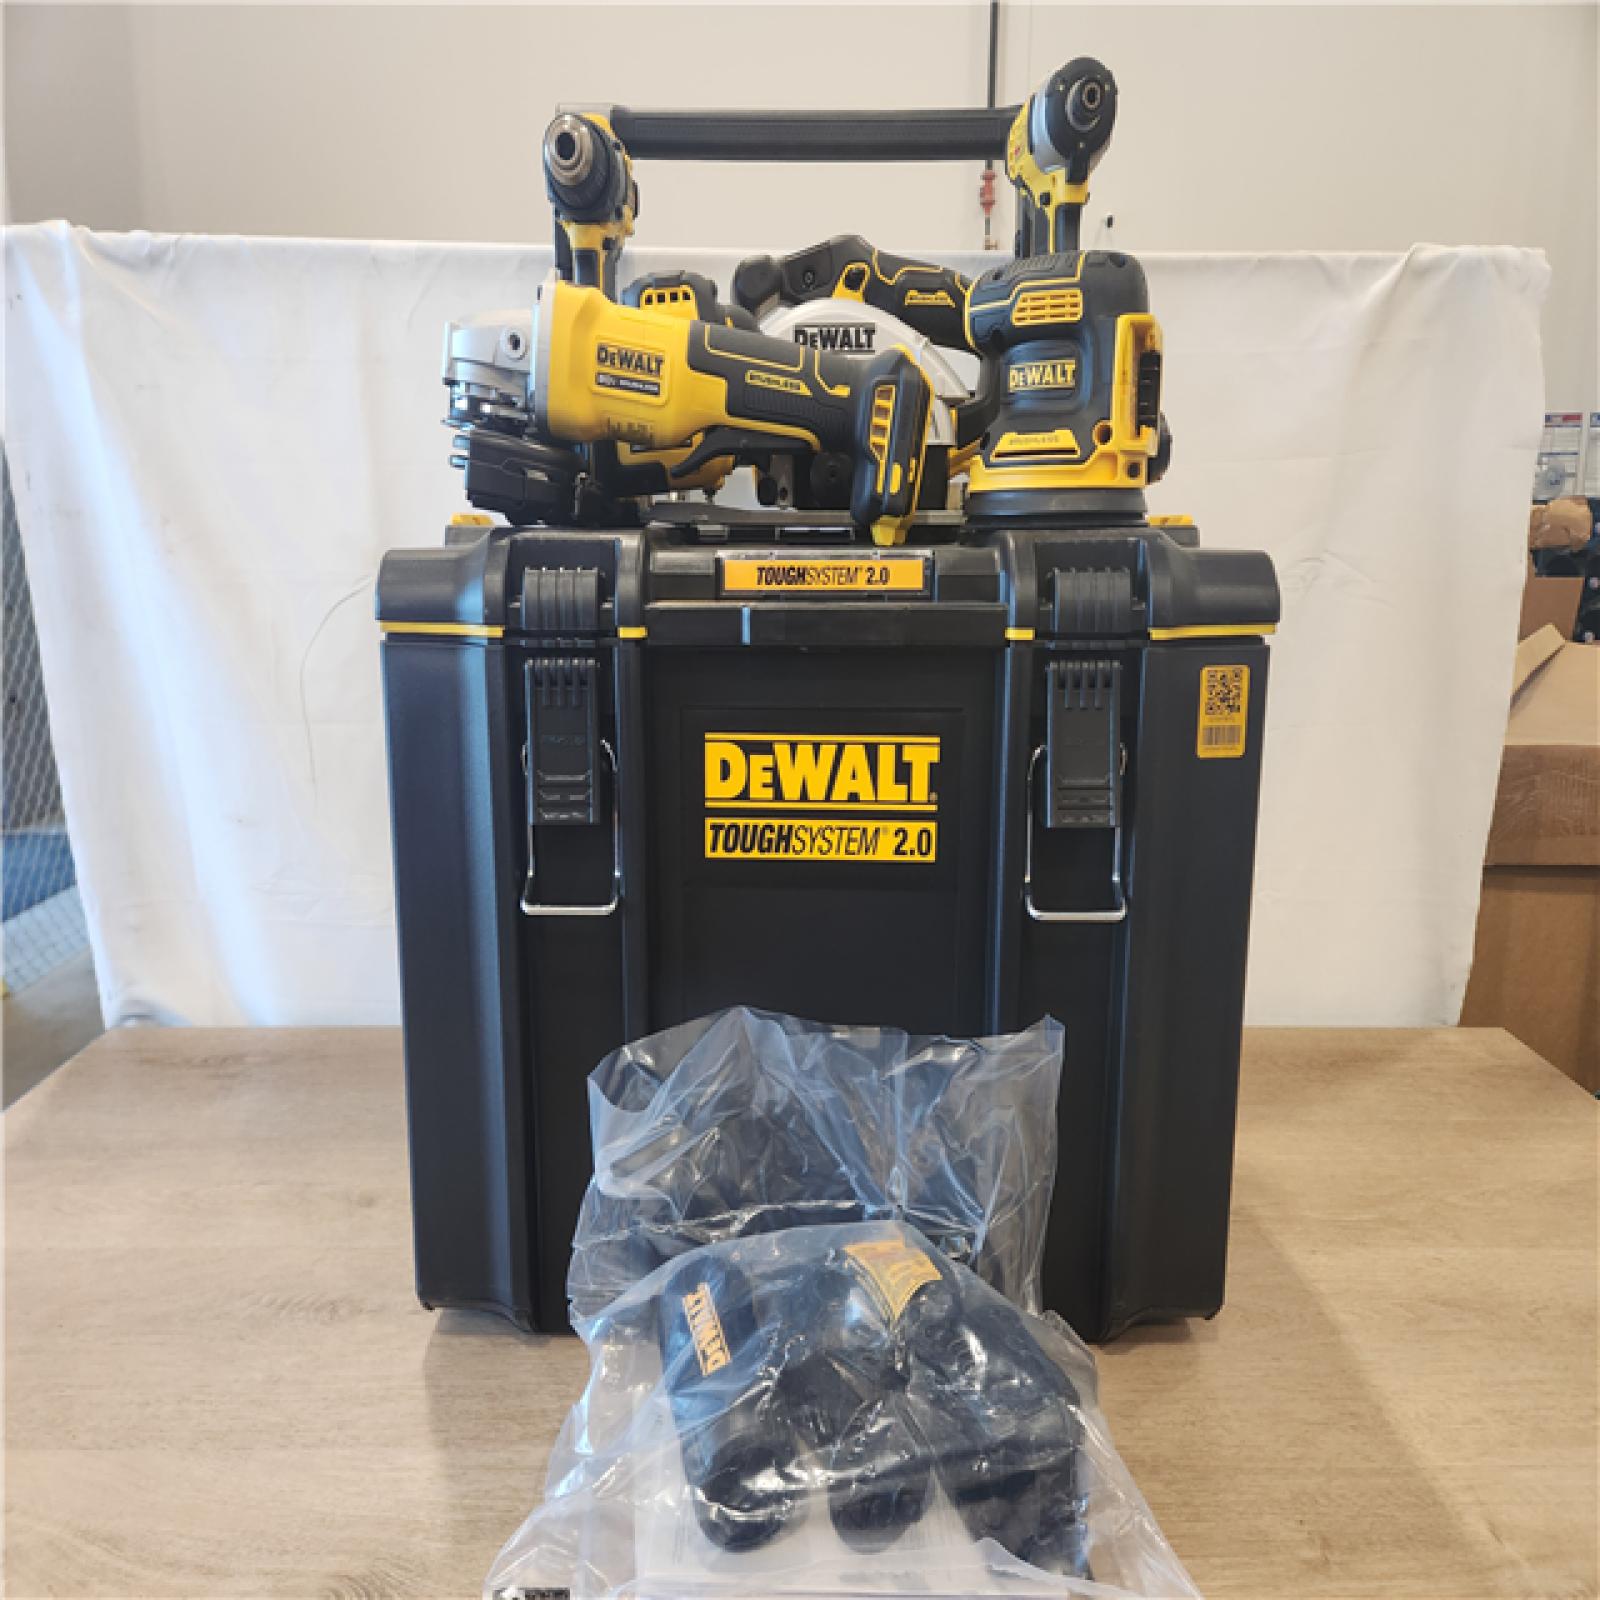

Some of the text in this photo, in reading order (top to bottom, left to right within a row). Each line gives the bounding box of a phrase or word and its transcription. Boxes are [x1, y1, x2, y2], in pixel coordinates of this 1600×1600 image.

[794, 328, 875, 350] DEWALT
[597, 344, 664, 376] DEWALT
[1010, 363, 1075, 386] DEWALT
[865, 566, 890, 586] 2.0
[705, 741, 941, 802] DEWALT
[893, 826, 932, 856] 2.0
